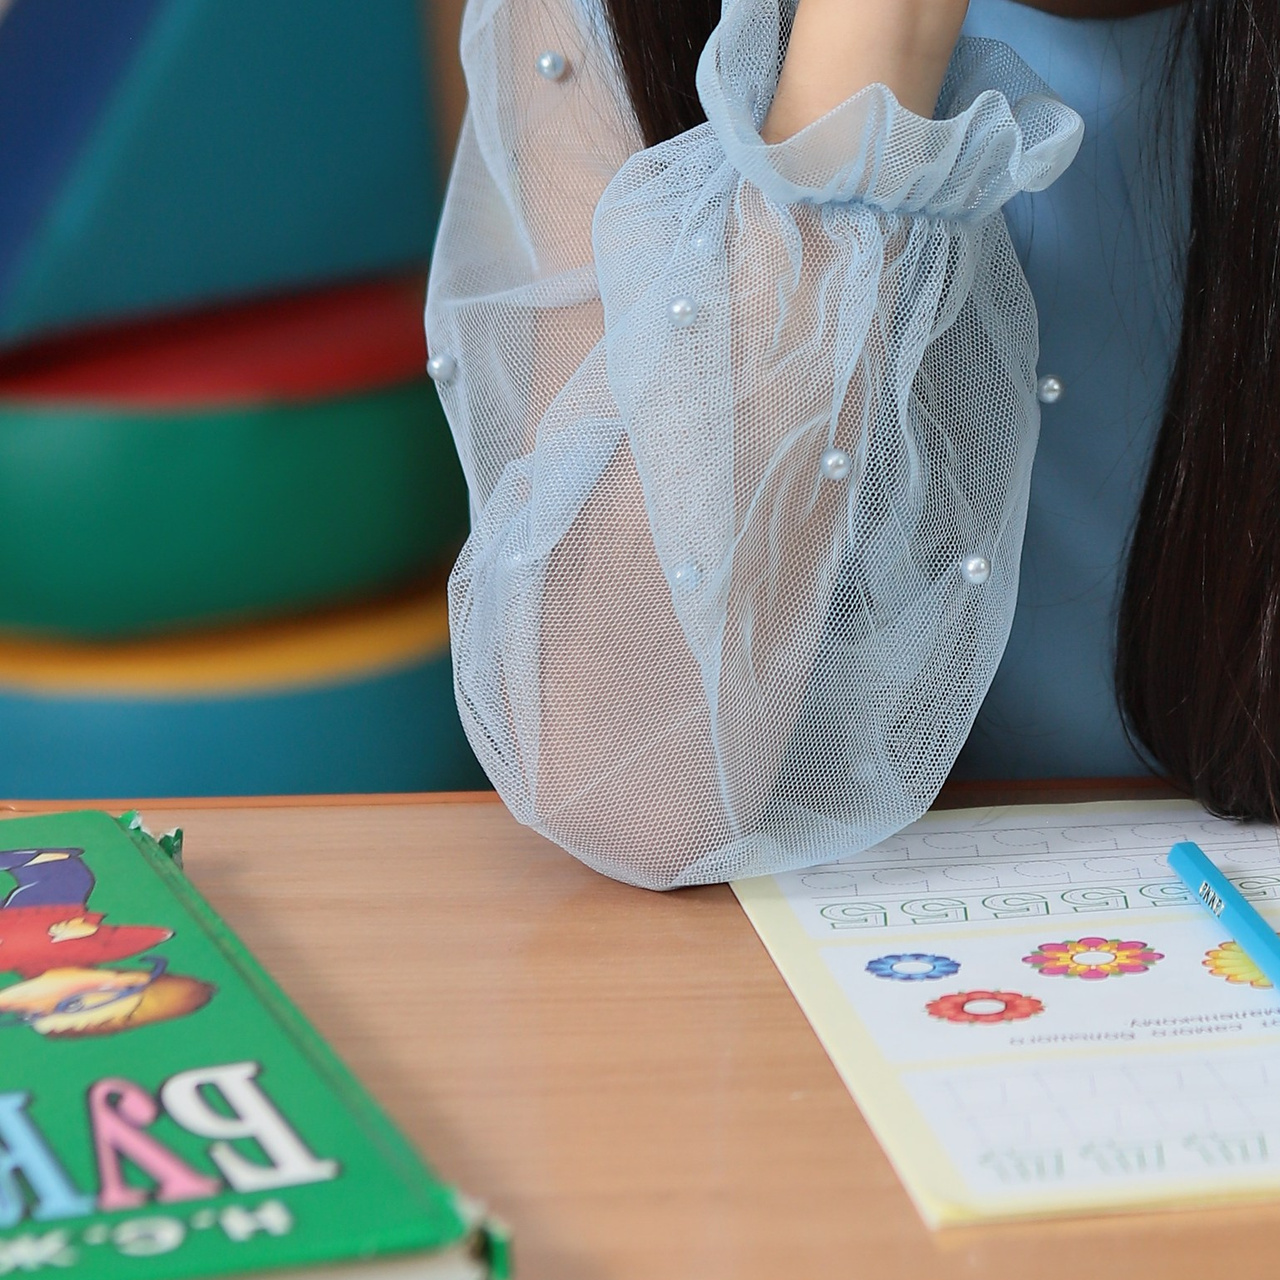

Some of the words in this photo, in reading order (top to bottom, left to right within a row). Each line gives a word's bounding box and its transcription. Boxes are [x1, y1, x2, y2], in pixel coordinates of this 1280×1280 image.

[900, 898, 968, 925] 5
[982, 892, 1050, 919] 5
[1060, 887, 1129, 913] 5
[820, 902, 888, 929] 5
[1008, 1032, 1136, 1048] большого
[1151, 1023, 1243, 1038] самого
